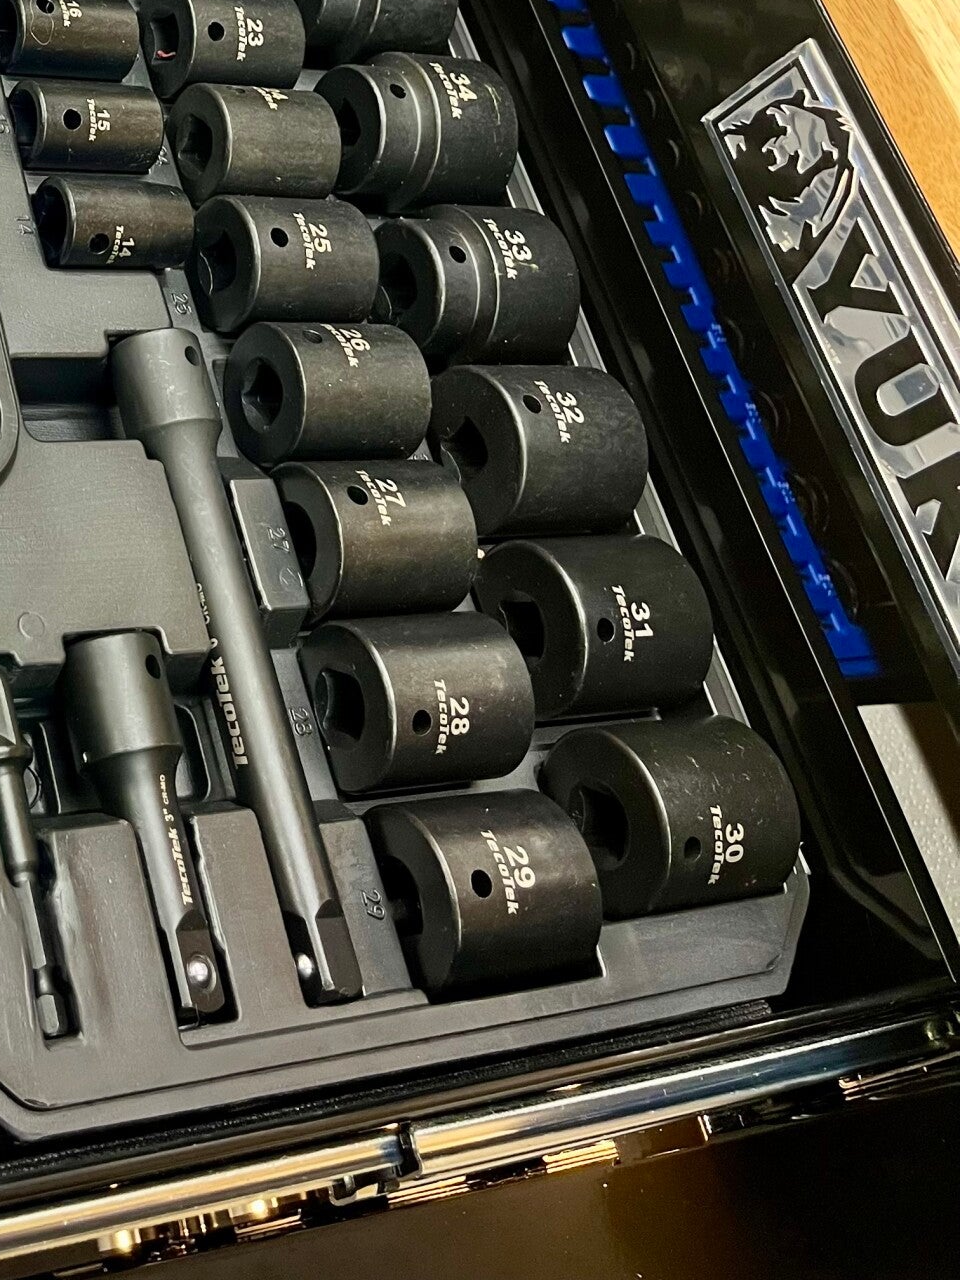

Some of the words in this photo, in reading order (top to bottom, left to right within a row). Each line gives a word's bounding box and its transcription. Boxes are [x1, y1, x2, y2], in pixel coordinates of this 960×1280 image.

[67, 0, 82, 19] 16
[246, 18, 264, 47] 23
[449, 71, 478, 102] 34
[96, 108, 111, 132] 15
[119, 236, 135, 259] 14
[309, 223, 333, 254] 25
[503, 228, 533, 262] 33
[339, 328, 371, 353] 26
[556, 390, 585, 425] 32
[375, 477, 407, 508] 27
[630, 601, 654, 639] 31
[450, 695, 471, 736] 28
[725, 822, 746, 865] 30
[503, 844, 537, 890] 29
